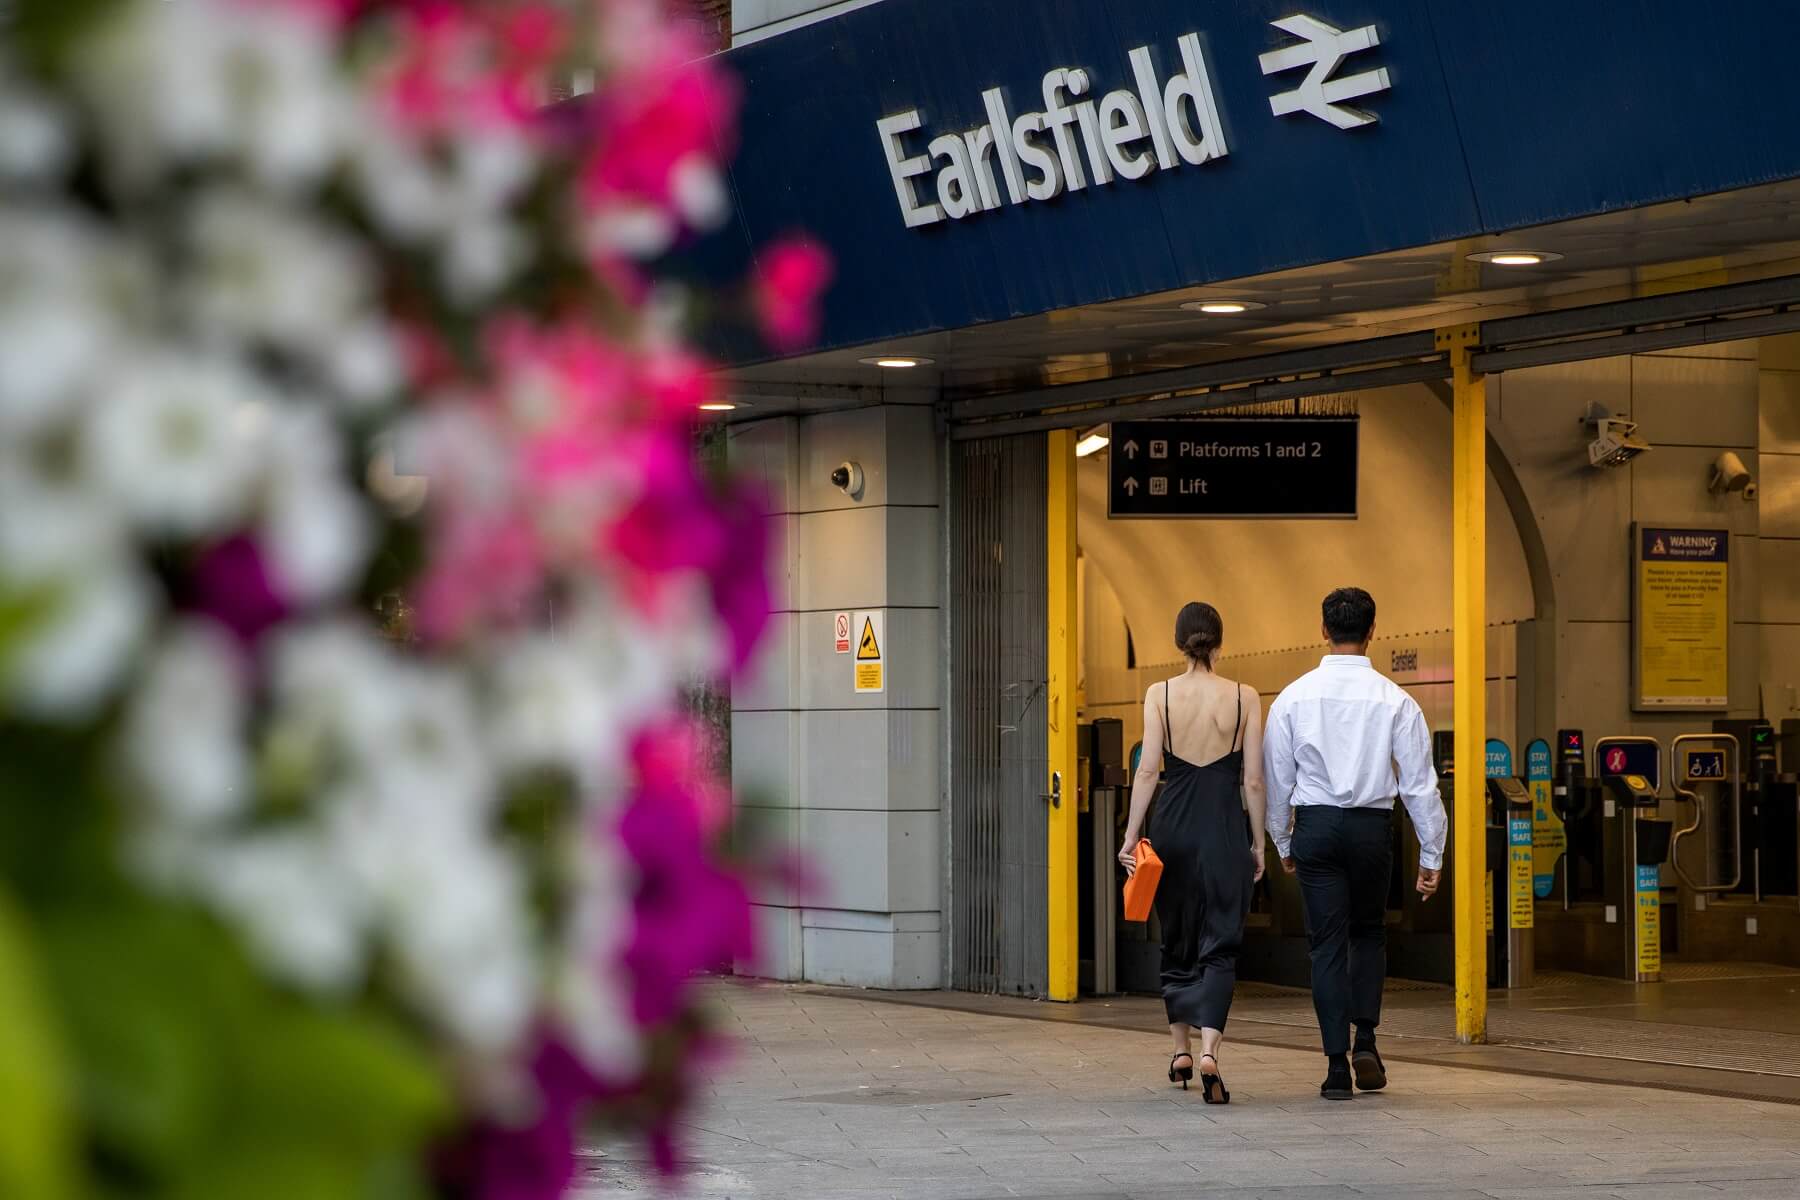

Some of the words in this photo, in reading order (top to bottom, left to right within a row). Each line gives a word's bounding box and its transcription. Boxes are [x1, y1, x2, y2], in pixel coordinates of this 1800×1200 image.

[876, 32, 1230, 229] Earlsfield
[1179, 442, 1260, 458] Platforms
[1265, 442, 1271, 457] 1
[1276, 442, 1306, 458] and
[1311, 442, 1322, 457] 2
[1179, 478, 1208, 494] Lift
[1669, 535, 1717, 547] WARNING
[1391, 647, 1418, 672] Earlsfield
[1531, 752, 1547, 762] STAY
[1531, 766, 1548, 776] SAFE
[1512, 822, 1530, 831] STAY
[1512, 832, 1531, 842] SAFE
[1639, 879, 1658, 888] SAFE
